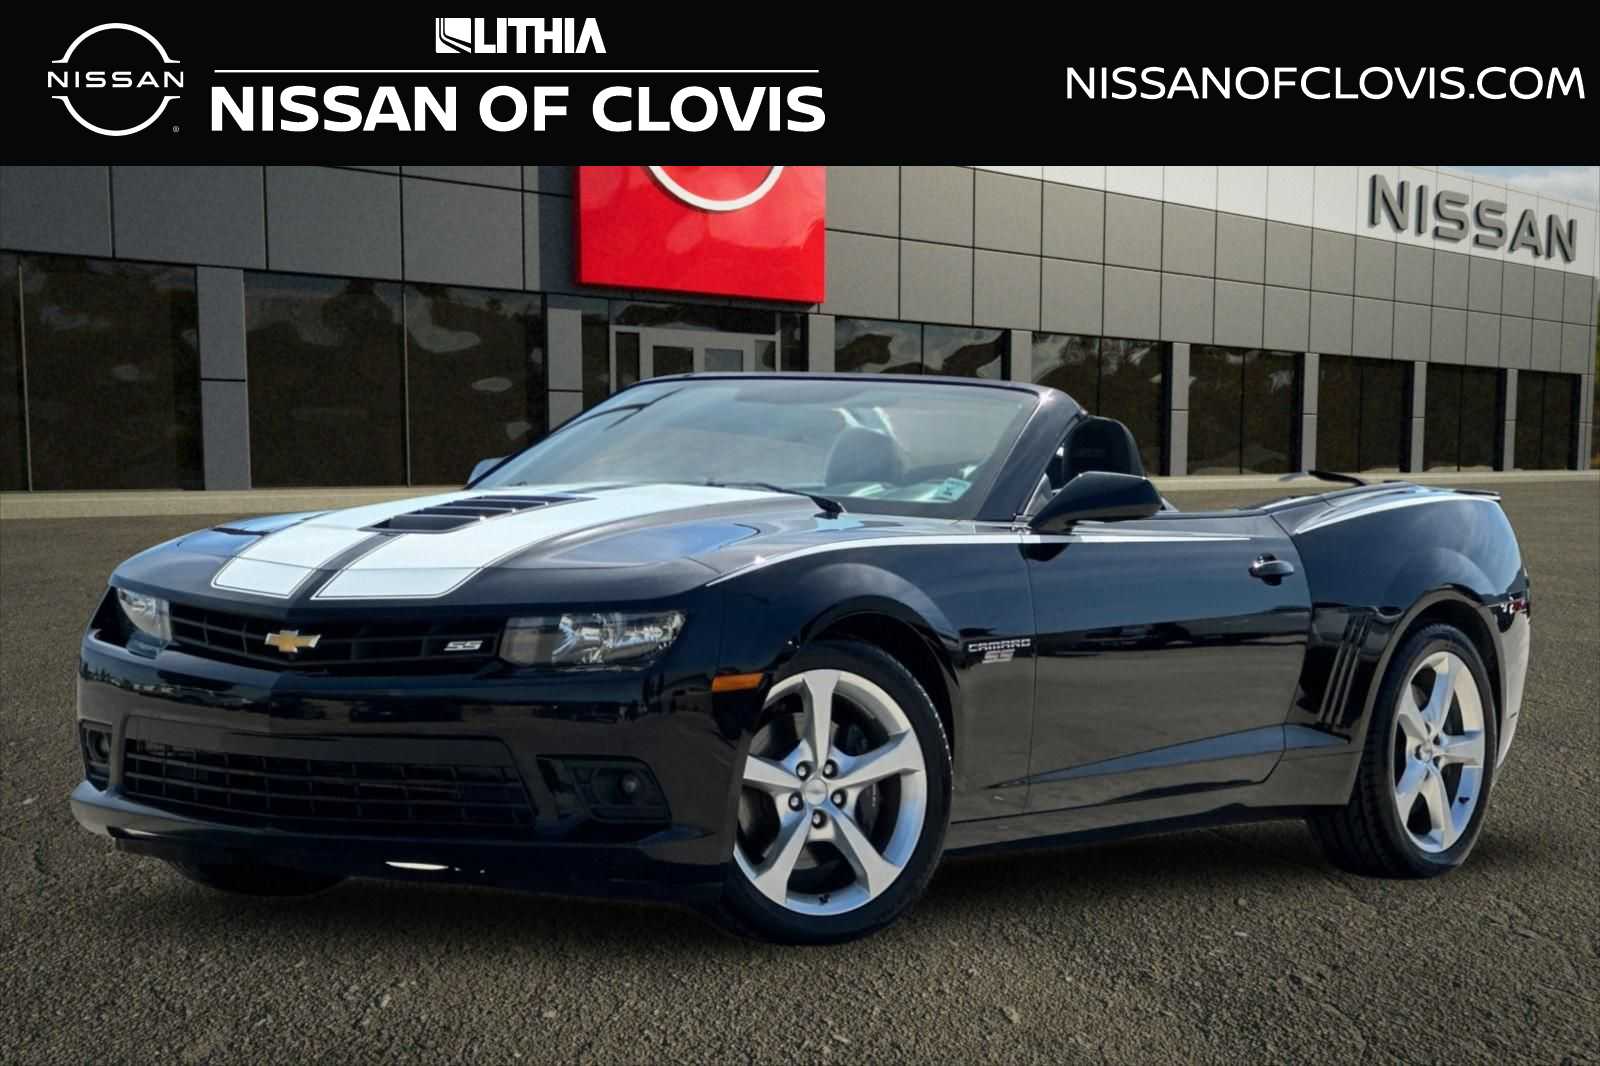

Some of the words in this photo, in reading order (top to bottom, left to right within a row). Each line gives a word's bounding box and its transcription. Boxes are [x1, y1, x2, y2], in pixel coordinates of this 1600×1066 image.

[1368, 173, 1578, 264] NISSAN
[443, 640, 483, 651] SS
[968, 638, 1031, 653] CAMARO
